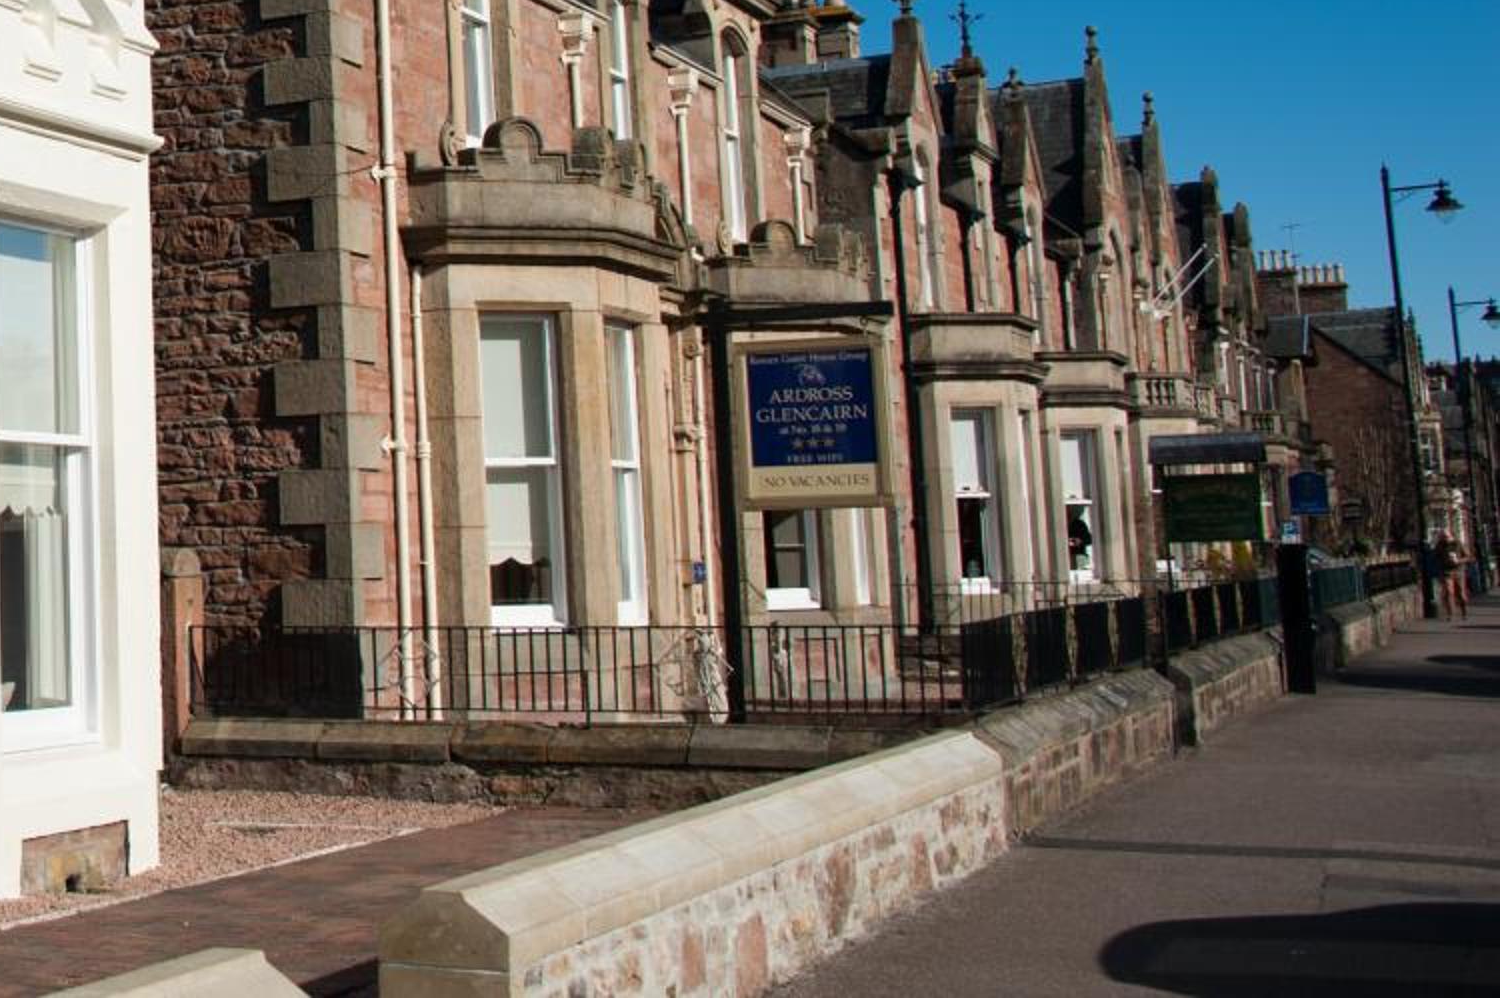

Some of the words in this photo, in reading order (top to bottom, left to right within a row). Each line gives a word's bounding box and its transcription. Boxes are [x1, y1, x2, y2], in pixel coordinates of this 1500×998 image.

[769, 386, 854, 404] ARDROSS
[756, 403, 869, 423] GLENCAIRN
[764, 474, 786, 488] NO
[789, 473, 869, 488] VACANCIES
